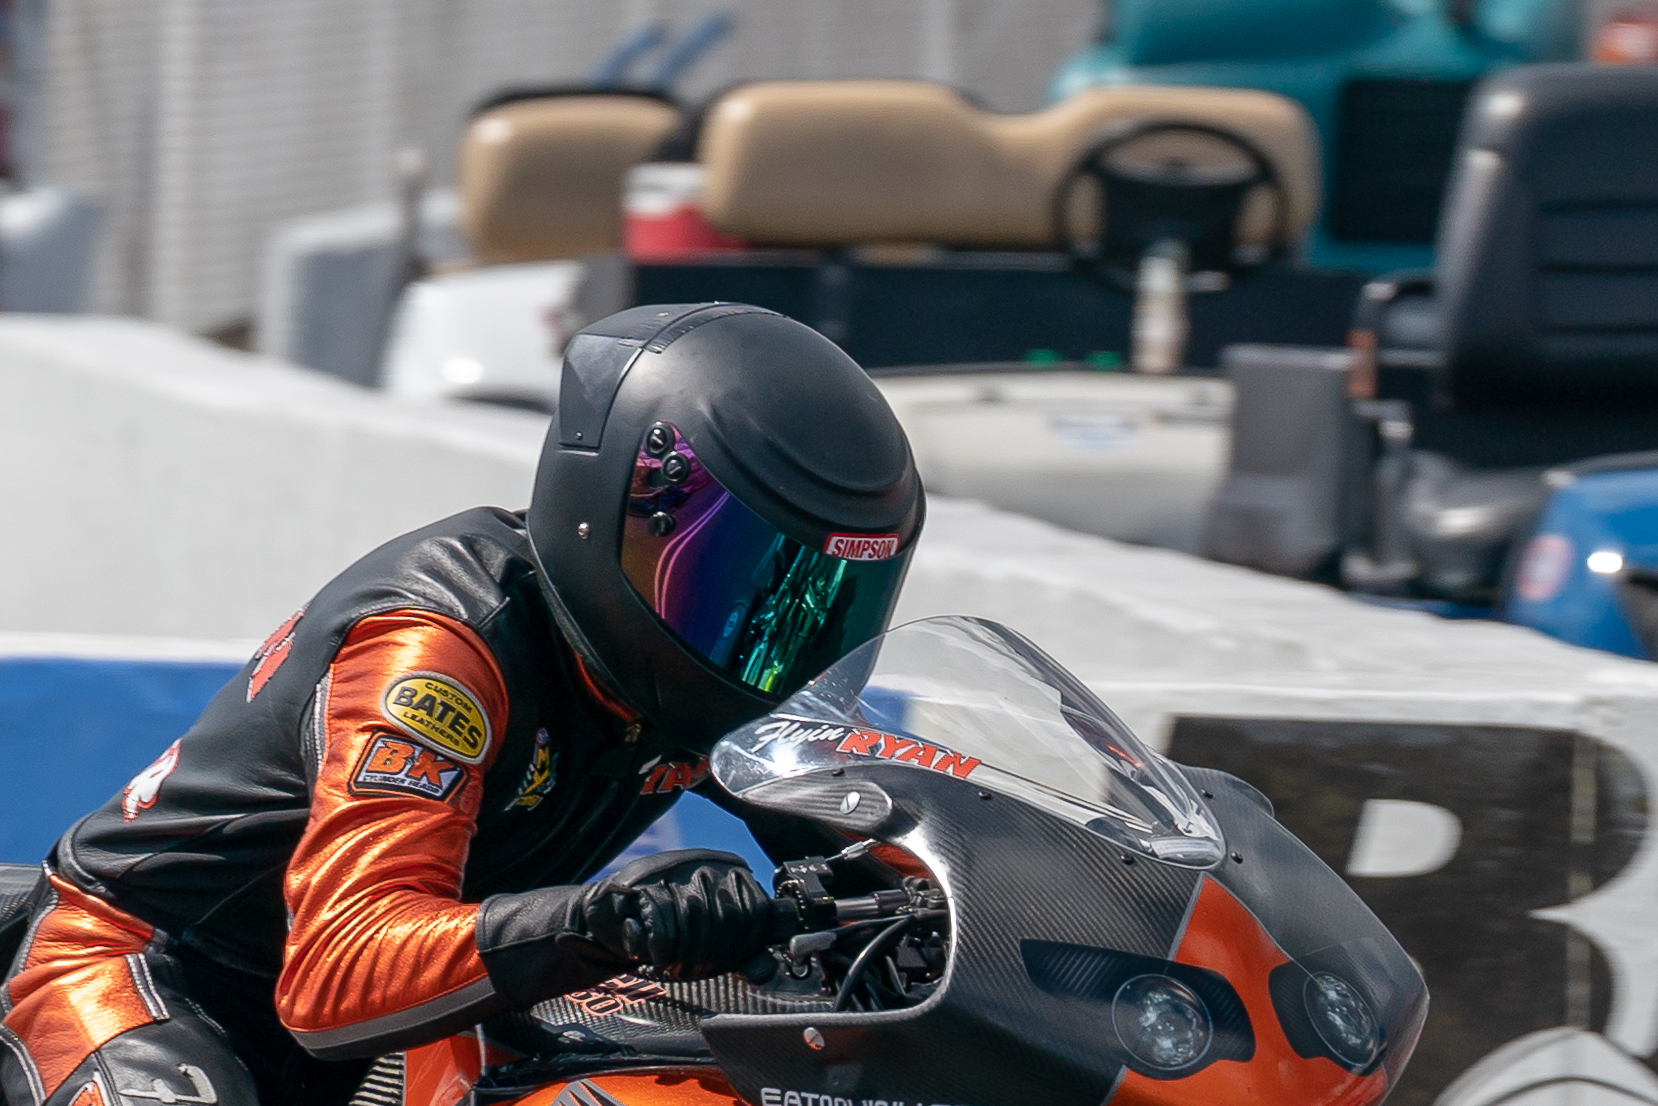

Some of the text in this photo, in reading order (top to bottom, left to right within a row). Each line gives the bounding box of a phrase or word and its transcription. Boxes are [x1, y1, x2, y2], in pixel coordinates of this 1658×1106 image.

[831, 539, 895, 559] SIMPSON
[425, 682, 472, 713] CUSTOM
[393, 686, 483, 750] BATES
[403, 711, 460, 747] LEATHERS
[750, 722, 981, 779] Flyin RYAN
